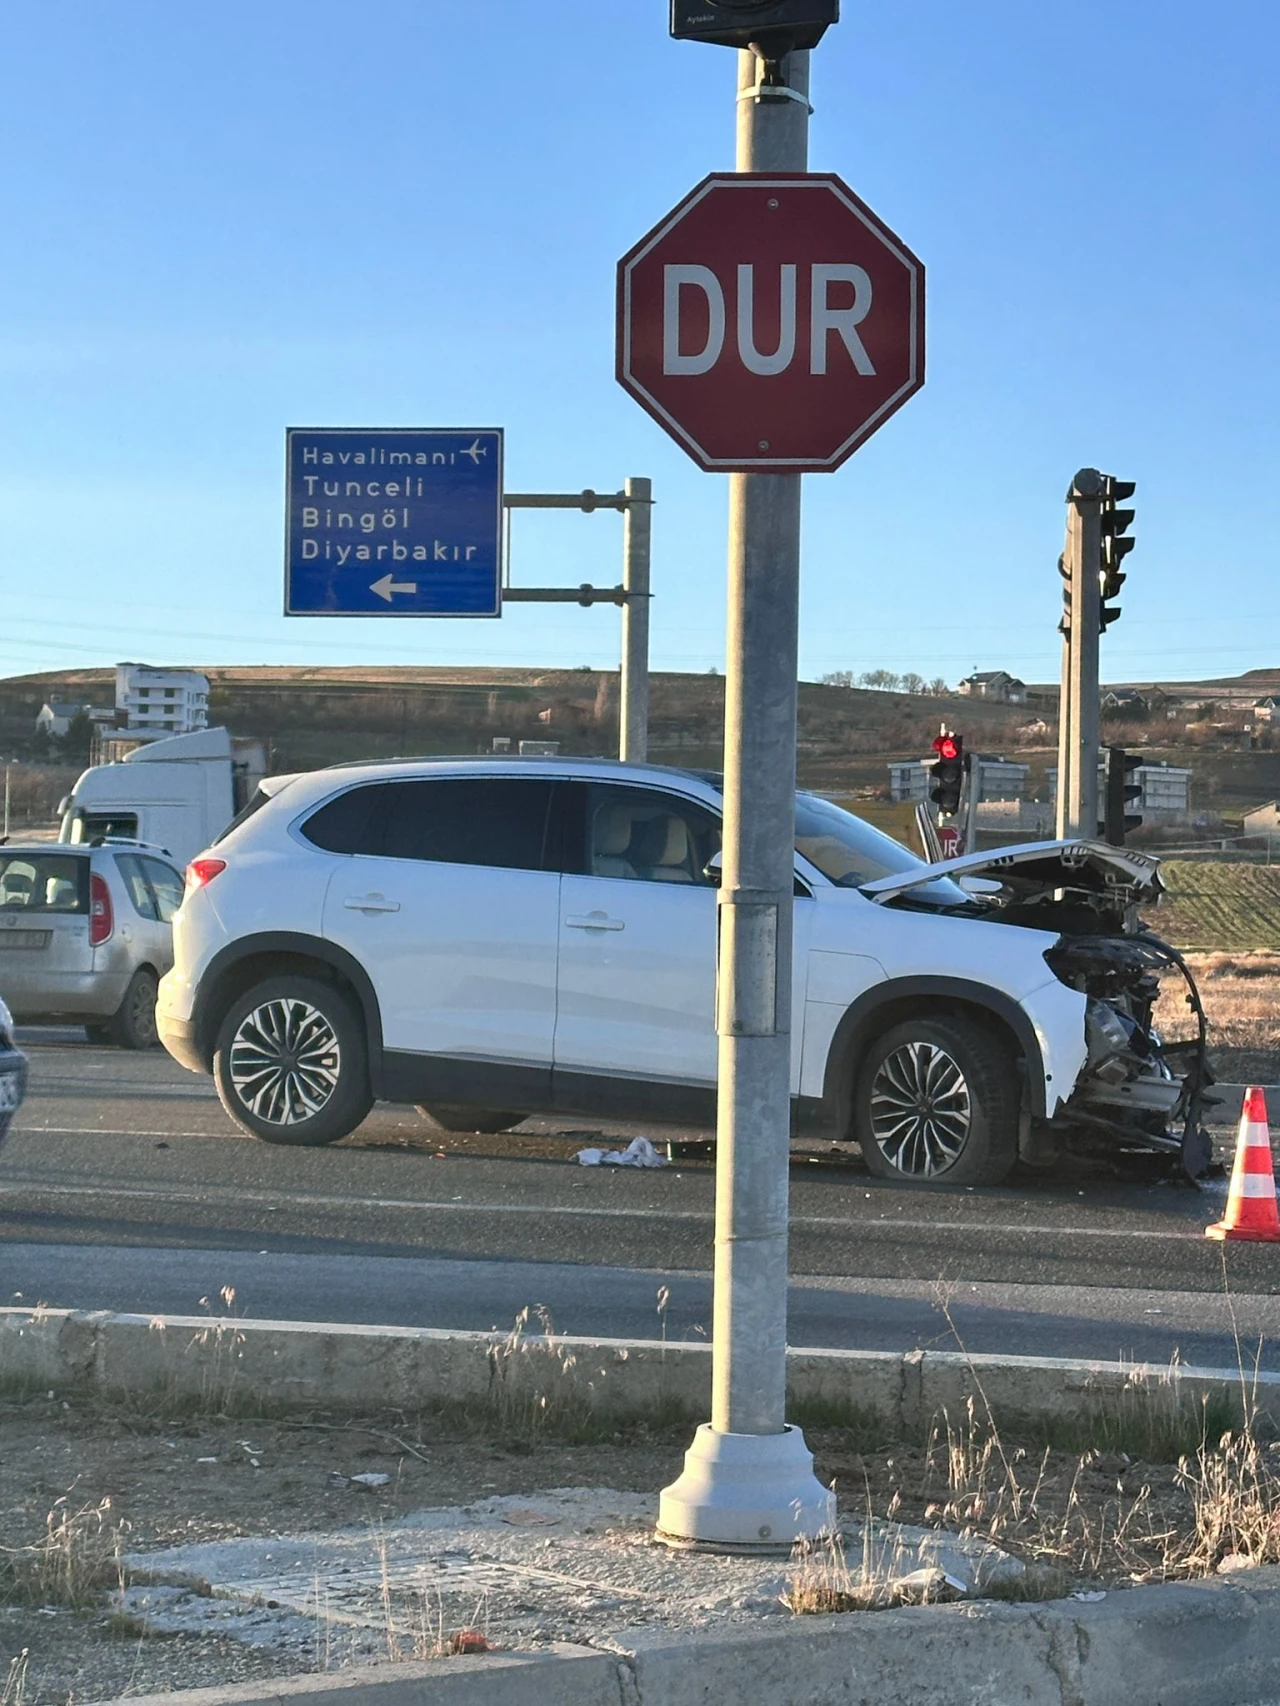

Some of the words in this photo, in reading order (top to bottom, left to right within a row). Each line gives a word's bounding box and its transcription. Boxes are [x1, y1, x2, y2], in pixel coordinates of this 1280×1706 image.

[662, 263, 877, 376] DUR
[302, 447, 455, 465] Havalimanı
[303, 475, 423, 497] Tunceli
[302, 507, 409, 533] Bingöl
[301, 538, 477, 565] Diyarbakır
